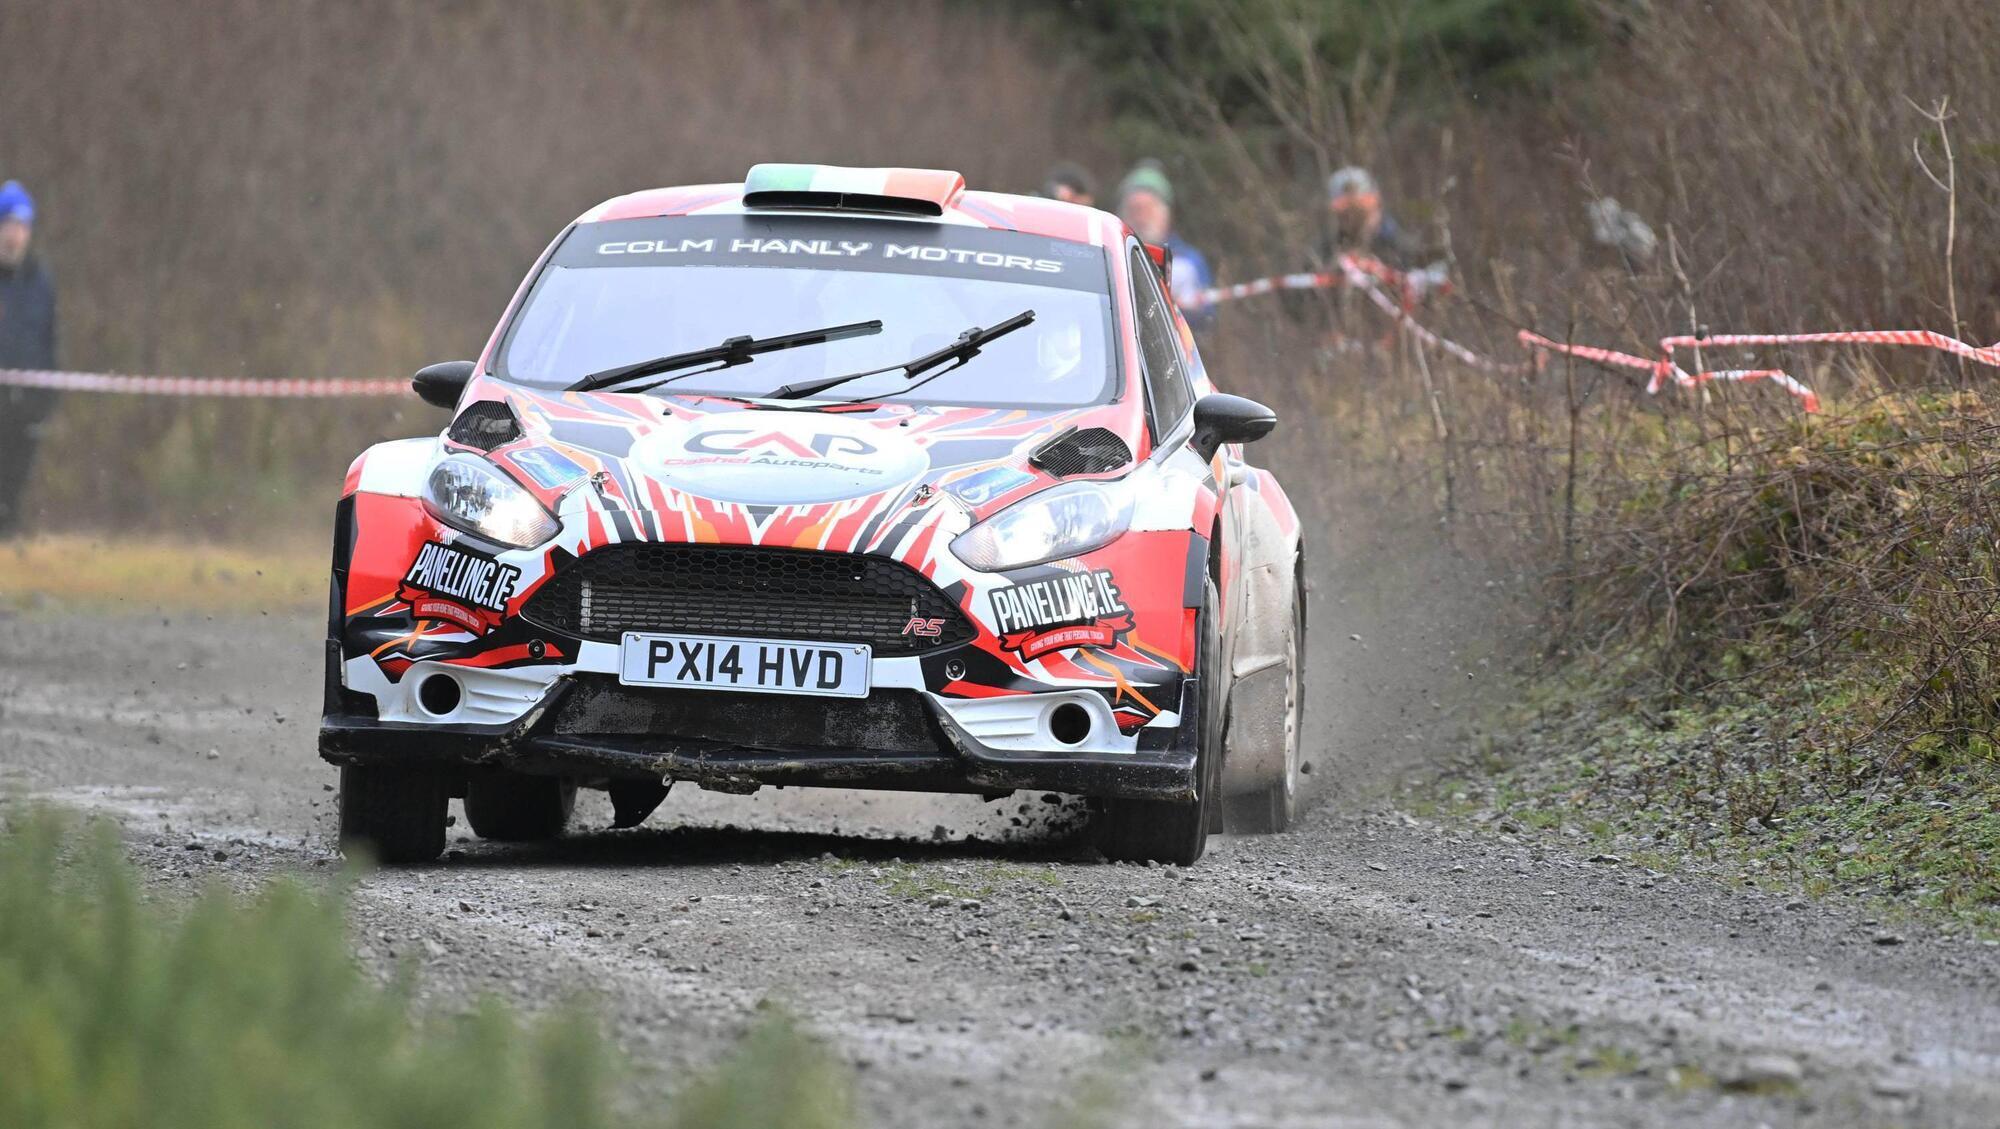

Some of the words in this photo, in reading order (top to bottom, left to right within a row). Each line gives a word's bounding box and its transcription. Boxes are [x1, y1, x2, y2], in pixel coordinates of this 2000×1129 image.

[598, 239, 714, 255] COLM
[731, 239, 872, 258] HANLY
[886, 244, 1063, 274] MOTORS
[684, 429, 877, 458] CAP
[664, 456, 751, 467] Cashel
[751, 457, 884, 476] Autoparts
[406, 543, 518, 612] PANELLING.IE
[992, 572, 1125, 634] PANELLING.IE
[902, 618, 945, 636] RS
[647, 640, 743, 683] PX14
[758, 646, 843, 690] HVD
